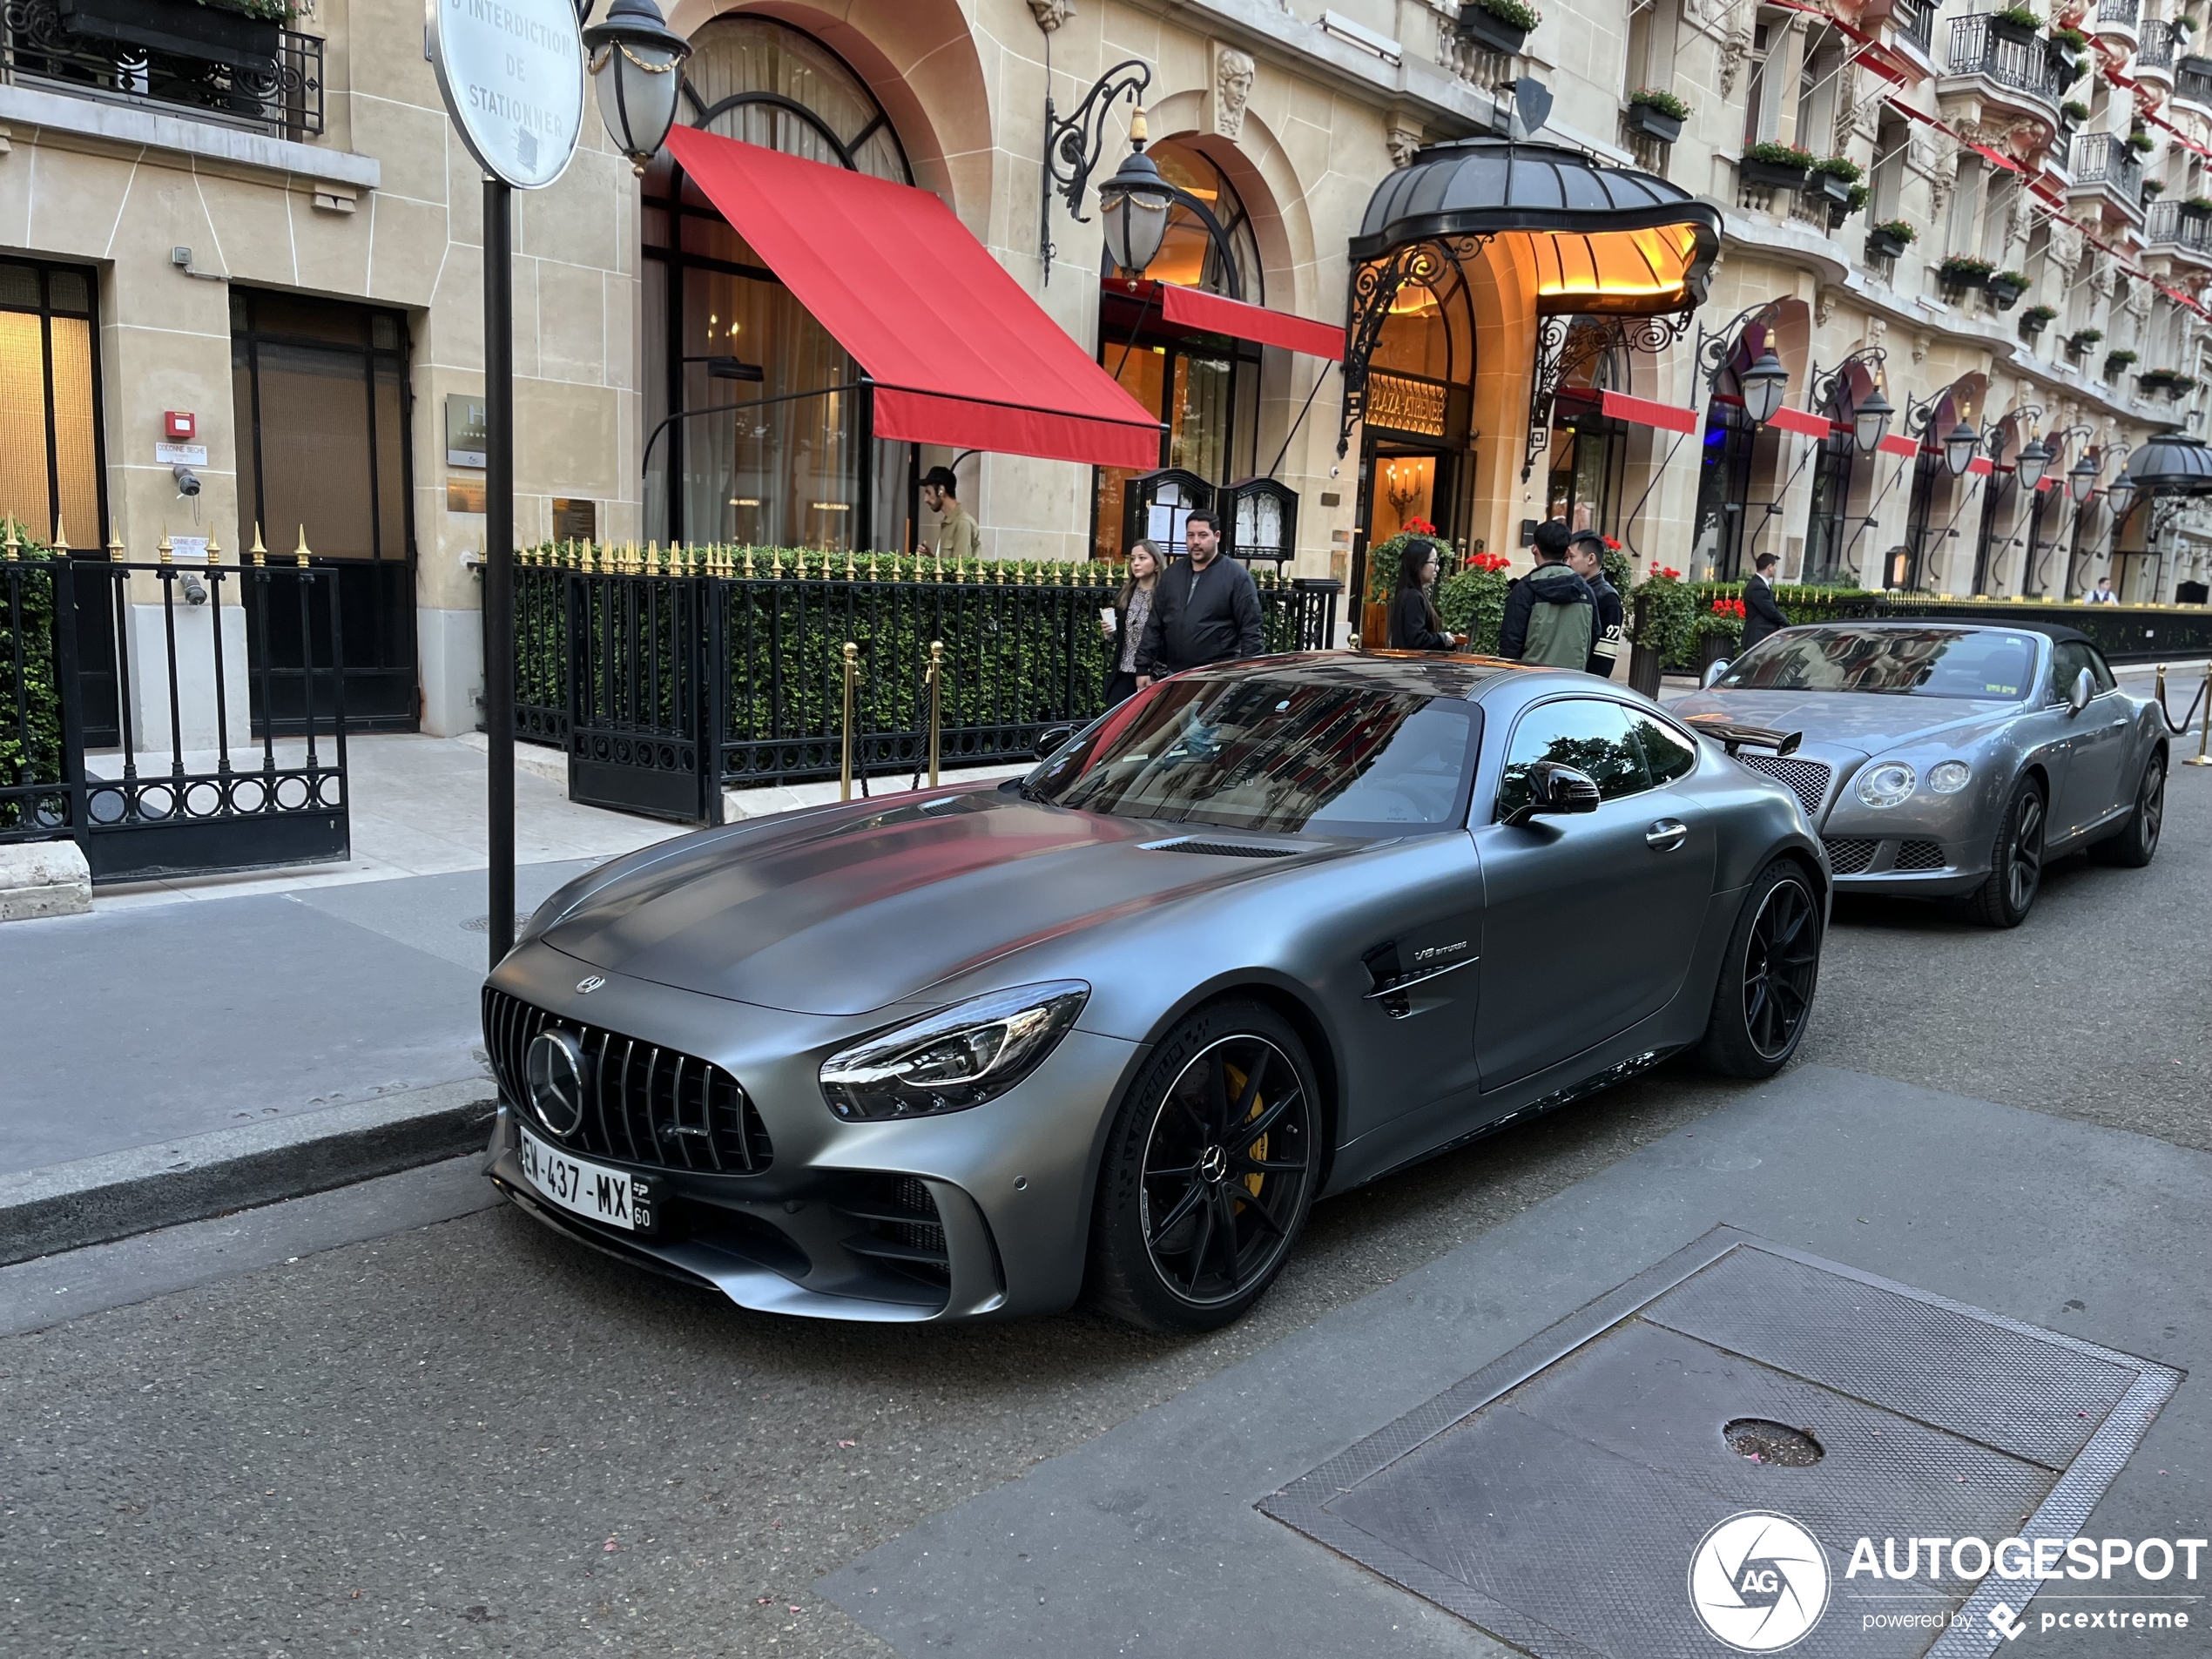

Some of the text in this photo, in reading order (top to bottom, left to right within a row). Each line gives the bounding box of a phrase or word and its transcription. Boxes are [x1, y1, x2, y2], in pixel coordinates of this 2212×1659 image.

[452, 0, 570, 57] INTERDICTION
[506, 53, 525, 81] DE
[469, 84, 563, 138] STATIONNER
[157, 443, 206, 455] COLONNE SECHE
[1606, 624, 1620, 639] 97
[1414, 941, 1467, 961] V8 BITURBO
[1133, 1043, 1184, 1135] MICHELIN
[634, 1207, 651, 1227] 60
